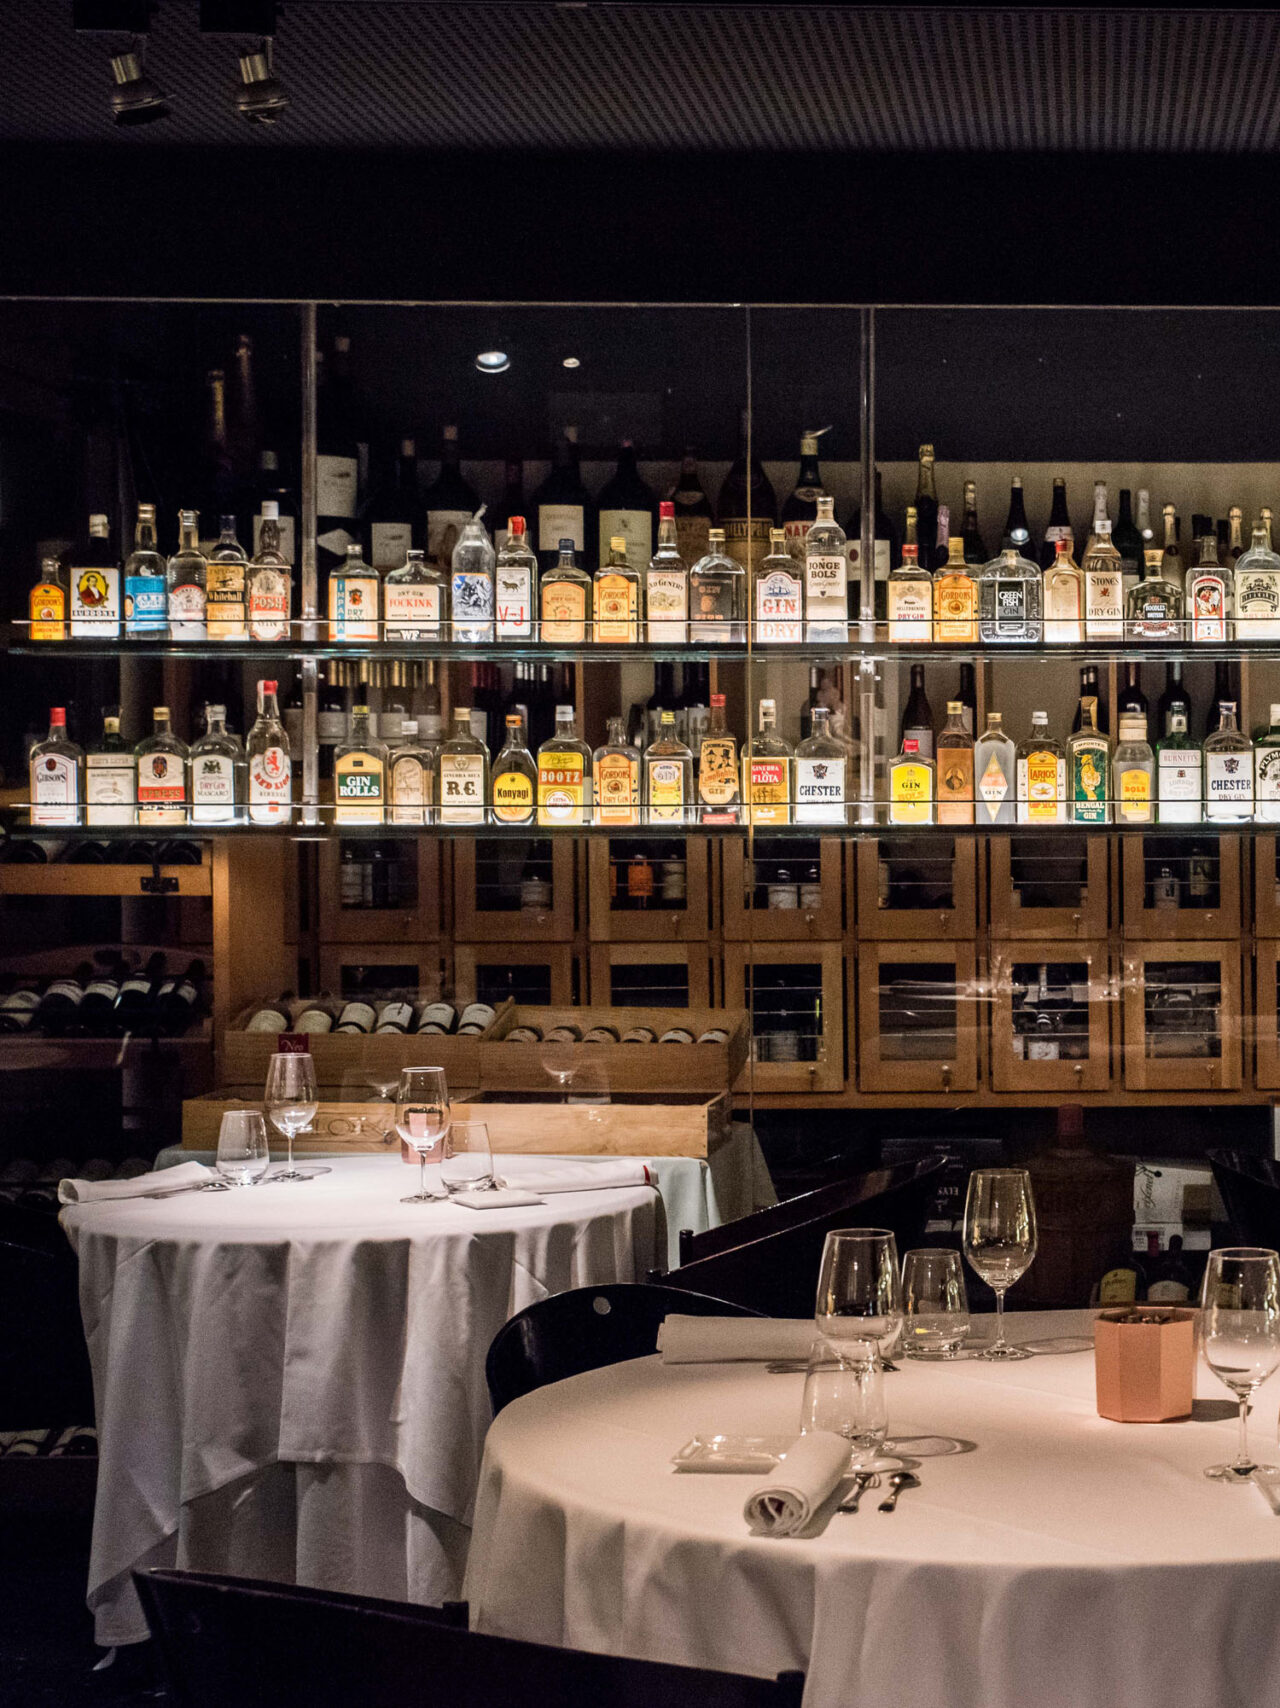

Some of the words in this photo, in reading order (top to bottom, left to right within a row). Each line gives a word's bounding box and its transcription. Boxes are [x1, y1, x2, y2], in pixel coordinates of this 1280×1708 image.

[809, 562, 840, 570] JONGE
[208, 592, 242, 601] Whitehall
[999, 591, 1023, 600] GREEN
[1242, 591, 1276, 602] BERKELEY
[253, 597, 283, 609] POSH
[389, 599, 433, 607] FOCKINK
[763, 599, 797, 614] GIN
[1003, 607, 1019, 615] GIN
[1089, 608, 1104, 616] DRY
[1107, 607, 1121, 616] GIN
[763, 623, 797, 639] DRY
[541, 771, 580, 782] BOOTZ
[752, 775, 778, 783] FLOTA
[1031, 769, 1055, 780] LARIOS
[254, 773, 272, 789] RED
[274, 773, 290, 790] LION
[346, 776, 371, 786] GIN
[1212, 780, 1251, 790] CHESTER
[340, 786, 380, 796] ROLLS
[497, 788, 529, 799] Konyagi
[800, 786, 841, 796] CHESTER
